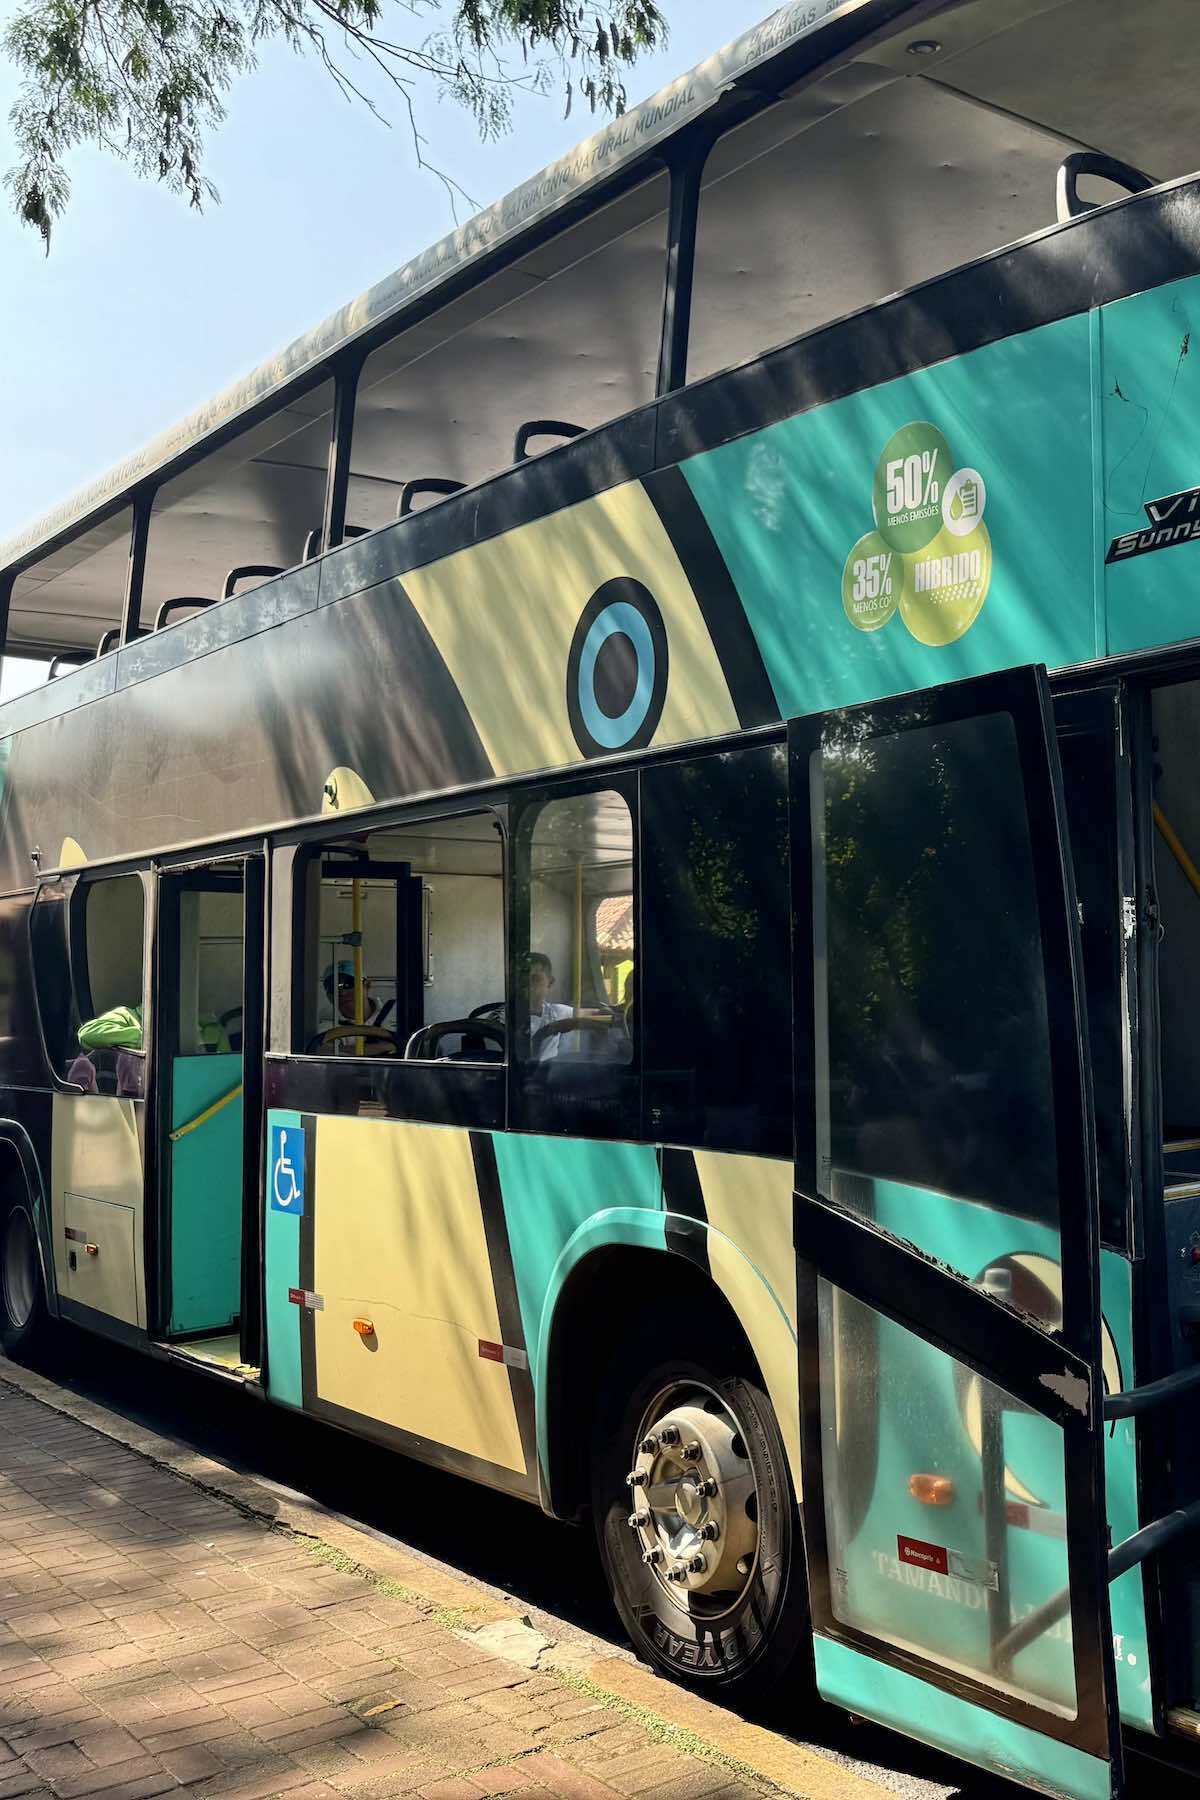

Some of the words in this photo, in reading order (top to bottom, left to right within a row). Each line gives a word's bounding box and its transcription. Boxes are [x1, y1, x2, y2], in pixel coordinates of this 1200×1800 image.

[573, 127, 630, 177] NATURAL
[633, 86, 695, 138] MUNDIAL
[886, 448, 939, 514] 50%
[887, 512, 909, 527] MENOS
[909, 504, 940, 522] EMISSÕES
[853, 552, 892, 601] 35%
[914, 551, 981, 593] HÍBRIDO
[853, 598, 878, 613] MENOS
